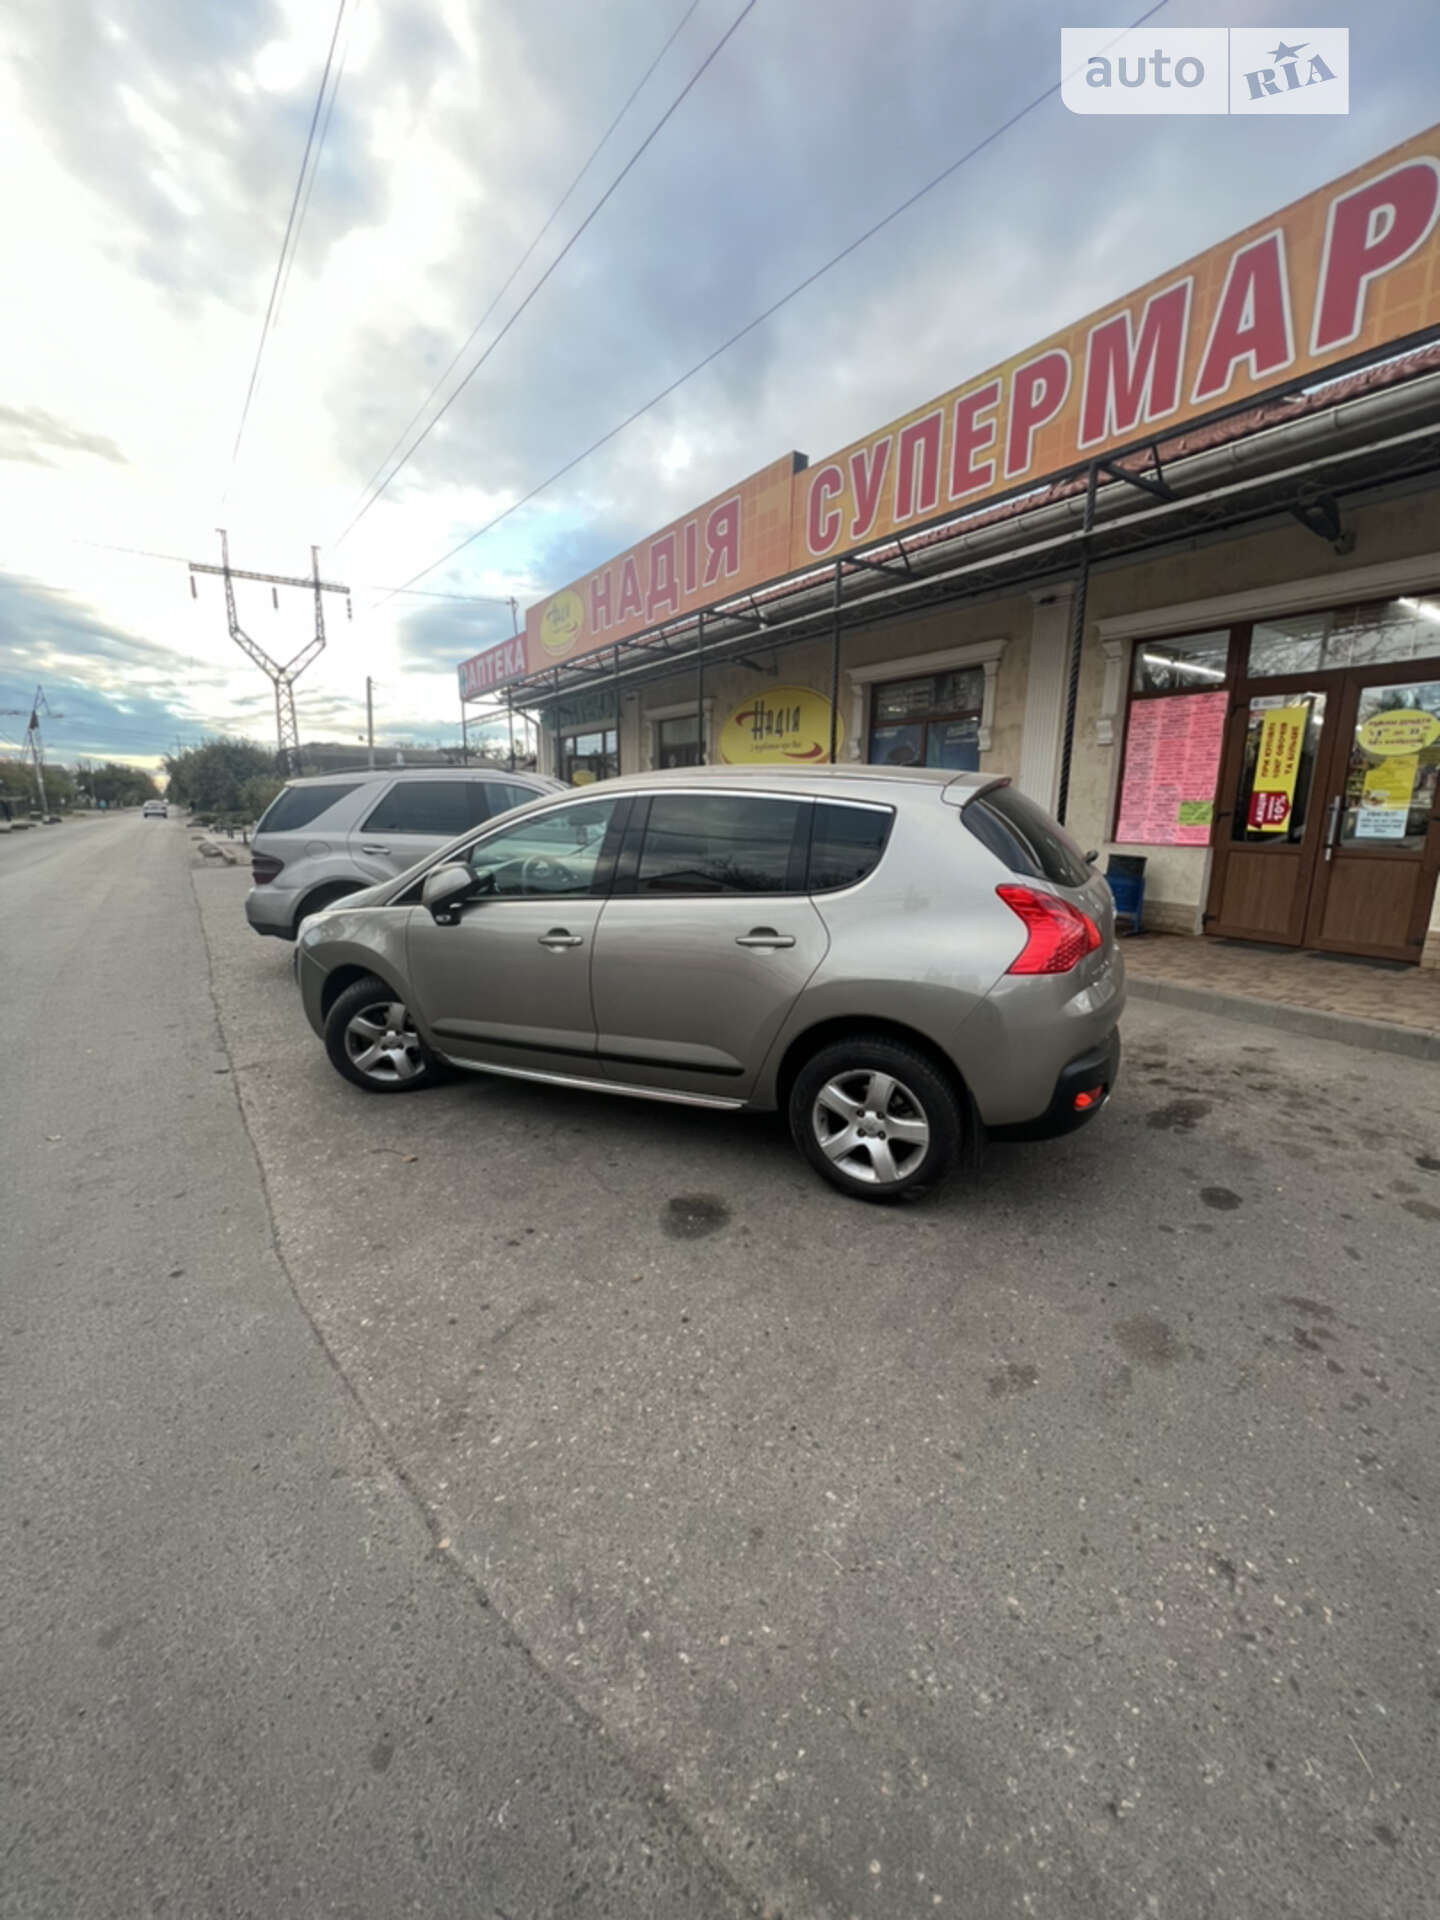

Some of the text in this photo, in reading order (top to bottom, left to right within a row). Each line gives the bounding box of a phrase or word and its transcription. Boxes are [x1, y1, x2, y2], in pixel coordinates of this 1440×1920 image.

[807, 155, 1440, 557] СУПЕРМАР
[590, 494, 742, 635] НАДІЯ
[467, 639, 526, 690] АПТЕКА
